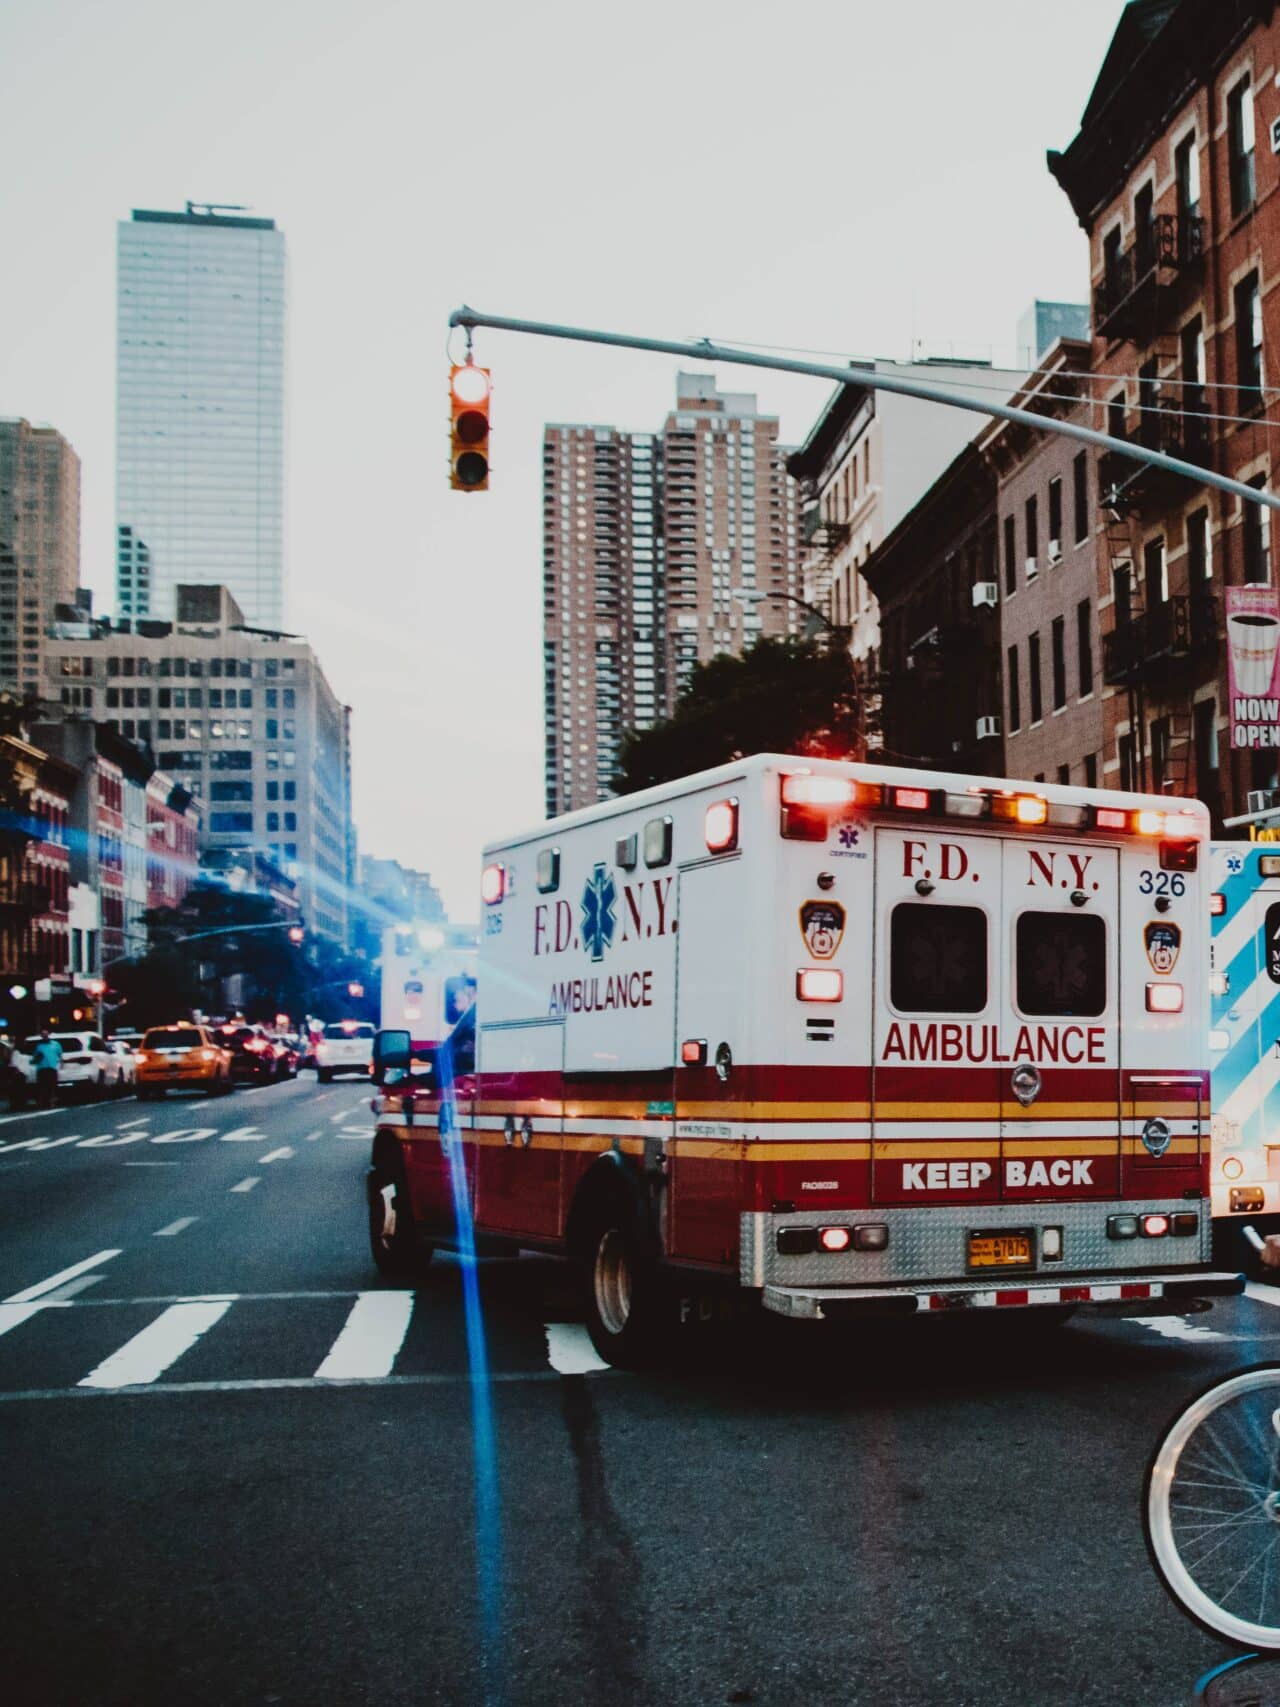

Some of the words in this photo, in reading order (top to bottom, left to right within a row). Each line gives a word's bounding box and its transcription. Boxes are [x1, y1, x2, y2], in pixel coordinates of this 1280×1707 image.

[1235, 699, 1279, 721] NOW
[1235, 725, 1280, 748] OPEN
[902, 840, 980, 882] F.D.
[1027, 850, 1100, 892] N.Y.
[1139, 870, 1185, 897] 326
[534, 900, 578, 956] F.D.
[621, 877, 679, 942] N.Y.
[549, 970, 653, 1016] AMBULANCE
[882, 1023, 1106, 1064] AMBULANCE
[902, 1162, 992, 1190] KEEP
[1006, 1159, 1093, 1187] BACK
